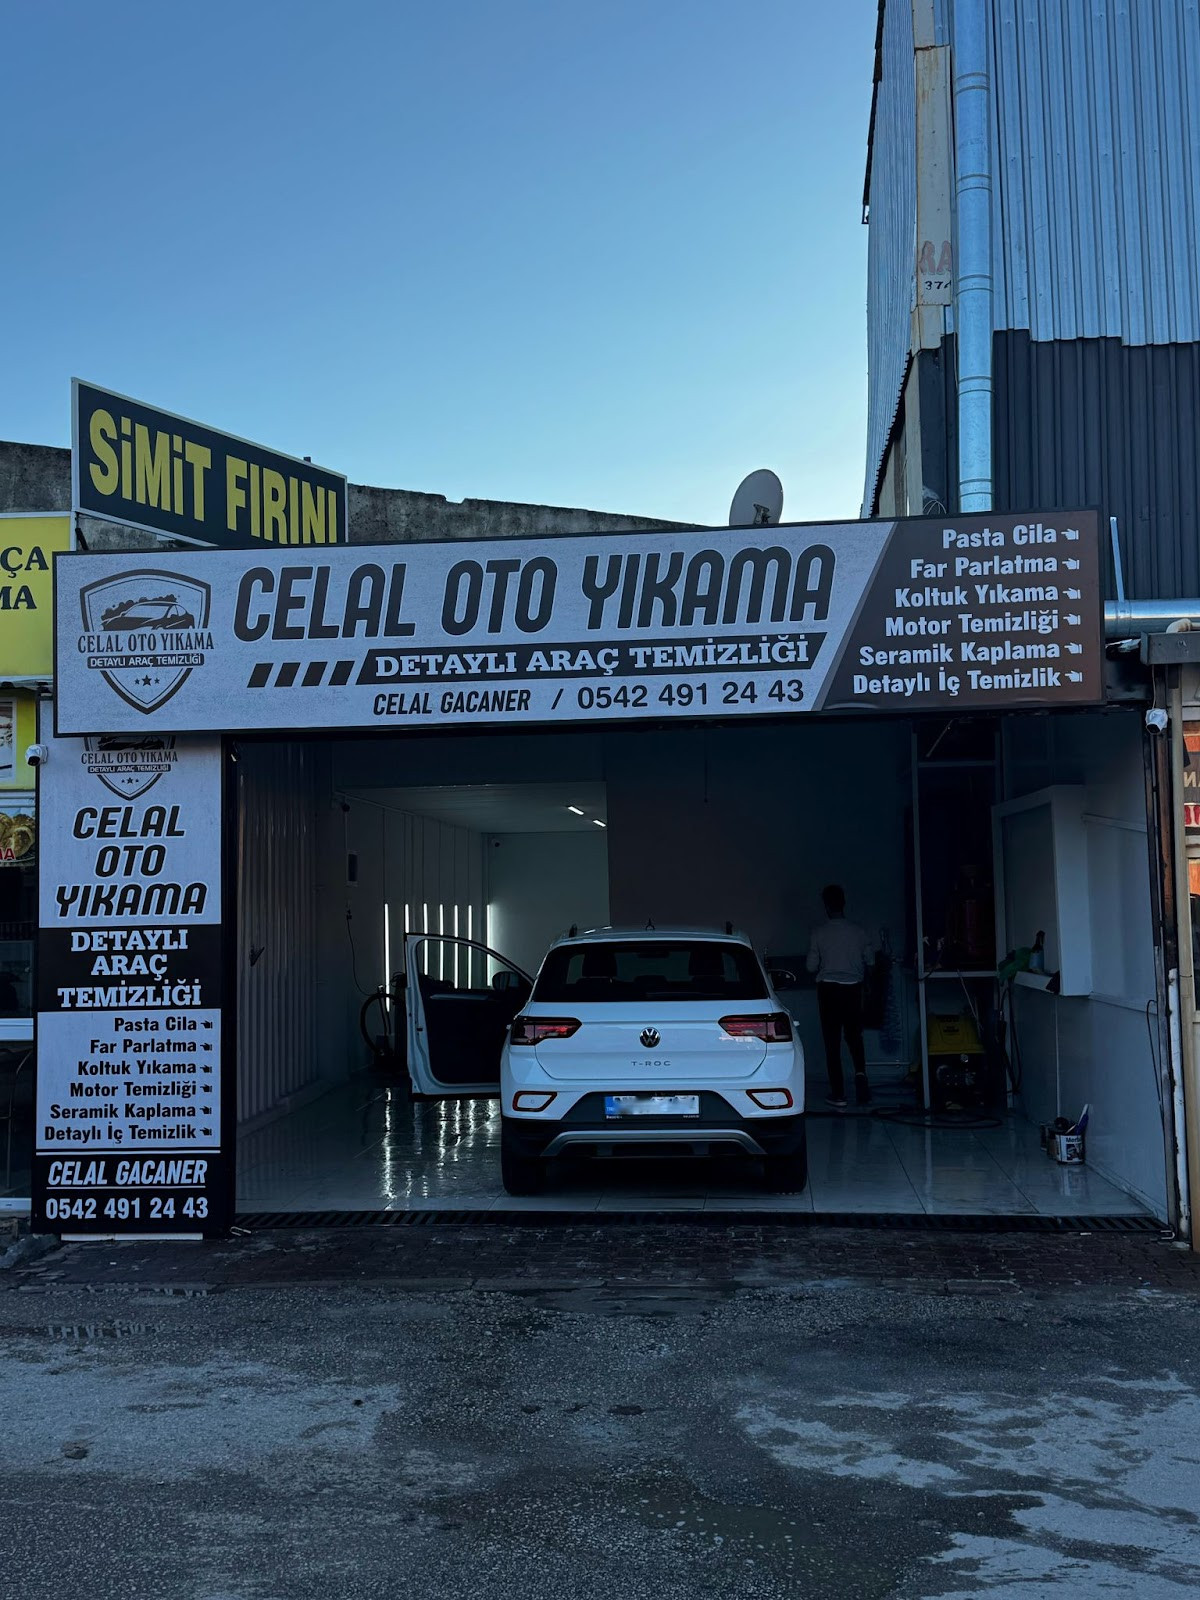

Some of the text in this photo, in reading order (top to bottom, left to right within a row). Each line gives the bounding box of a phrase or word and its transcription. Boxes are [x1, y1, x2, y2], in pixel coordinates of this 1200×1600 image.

[225, 454, 337, 544] FIRINI
[942, 523, 1057, 549] Pasta Cila
[910, 556, 1058, 579] Far Parlatma
[233, 544, 836, 642] CELAL OTO YIKAMA
[895, 584, 1058, 608] Koltuk Yıkama
[885, 609, 1059, 637] Motor Temizliği
[77, 631, 214, 654] CELAL OTO YIKAMA
[375, 634, 809, 677] DETAYLI ARAÇ TEMİZLİĞİ
[859, 640, 1060, 666] Seramik Kaplama
[90, 653, 201, 668] DETAYLI ARAÇ TEMİZLİĞİ
[853, 667, 1062, 697] Detaylı İç Temizlik
[373, 679, 804, 716] CELAL GACANER / 0542 491 24 43
[81, 751, 178, 764] CELAL OTO YIKAMA
[73, 805, 185, 838] CELAL
[95, 845, 166, 877] OTO
[56, 882, 208, 917] YIKAMA
[70, 930, 188, 951] DETAYLI
[91, 954, 167, 980] ARAÇ
[57, 978, 201, 1008] TEMİZLİĞİ
[115, 1016, 197, 1032] Pasta Cila
[90, 1038, 197, 1054] Far Parlatma
[78, 1060, 197, 1076] Koltuk Yıkama
[70, 1081, 197, 1099] Motor Temizliği
[50, 1103, 196, 1120] Seramik Kaplama
[44, 1121, 197, 1144] Detaylı İç Temizlik
[48, 1160, 208, 1186] CELAL GACANER
[46, 1197, 209, 1219] 0542 491 24 43
